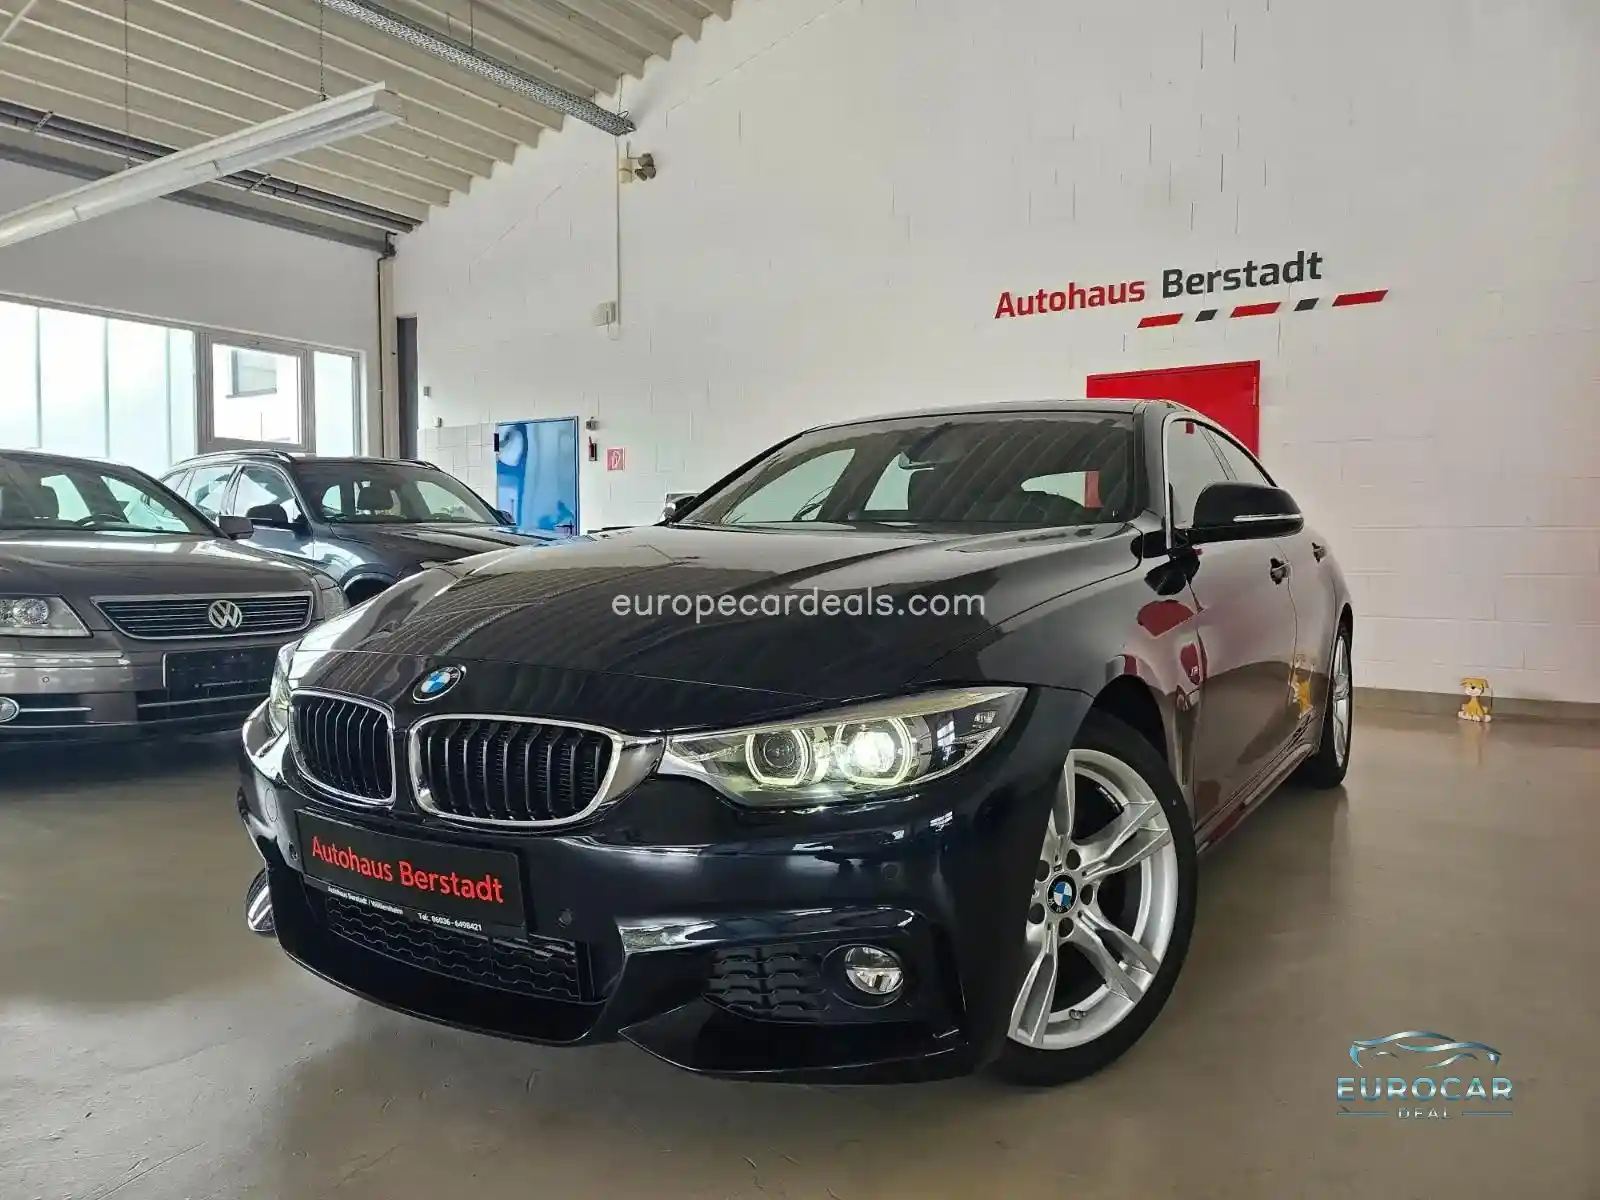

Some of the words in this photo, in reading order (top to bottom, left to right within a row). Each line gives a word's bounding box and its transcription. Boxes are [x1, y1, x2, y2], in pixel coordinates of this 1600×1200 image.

[995, 280, 1146, 319] Autohaus
[1162, 250, 1323, 298] Berstadt
[312, 836, 393, 881] Autohaus
[400, 861, 503, 903] Berstadt
